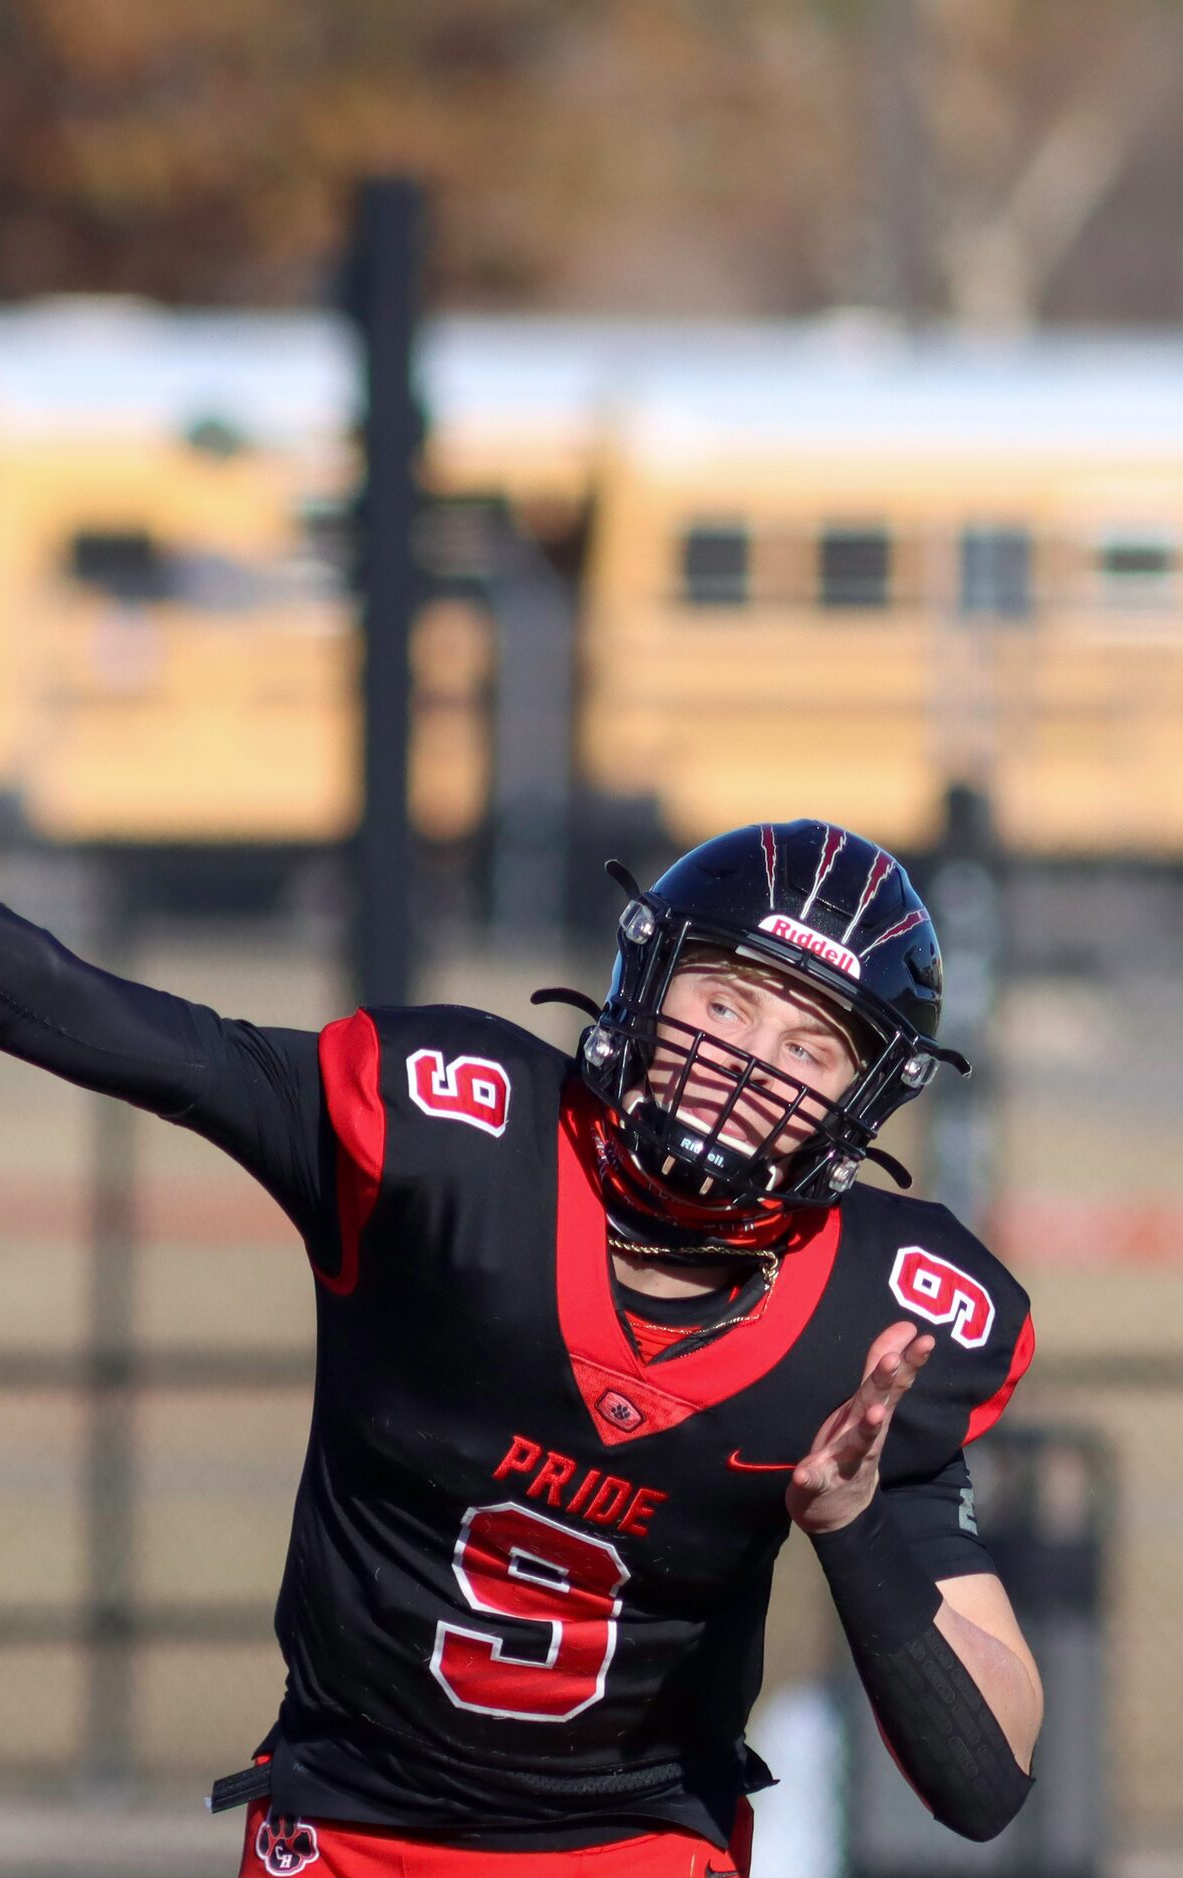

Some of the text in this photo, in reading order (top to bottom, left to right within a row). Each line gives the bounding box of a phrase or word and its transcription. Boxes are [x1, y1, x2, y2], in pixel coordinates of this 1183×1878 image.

[772, 919, 854, 972] Riddell
[405, 1048, 511, 1138] 9
[888, 1246, 995, 1349] 9
[492, 1435, 668, 1537] PRIDE
[429, 1501, 632, 1723] 9
